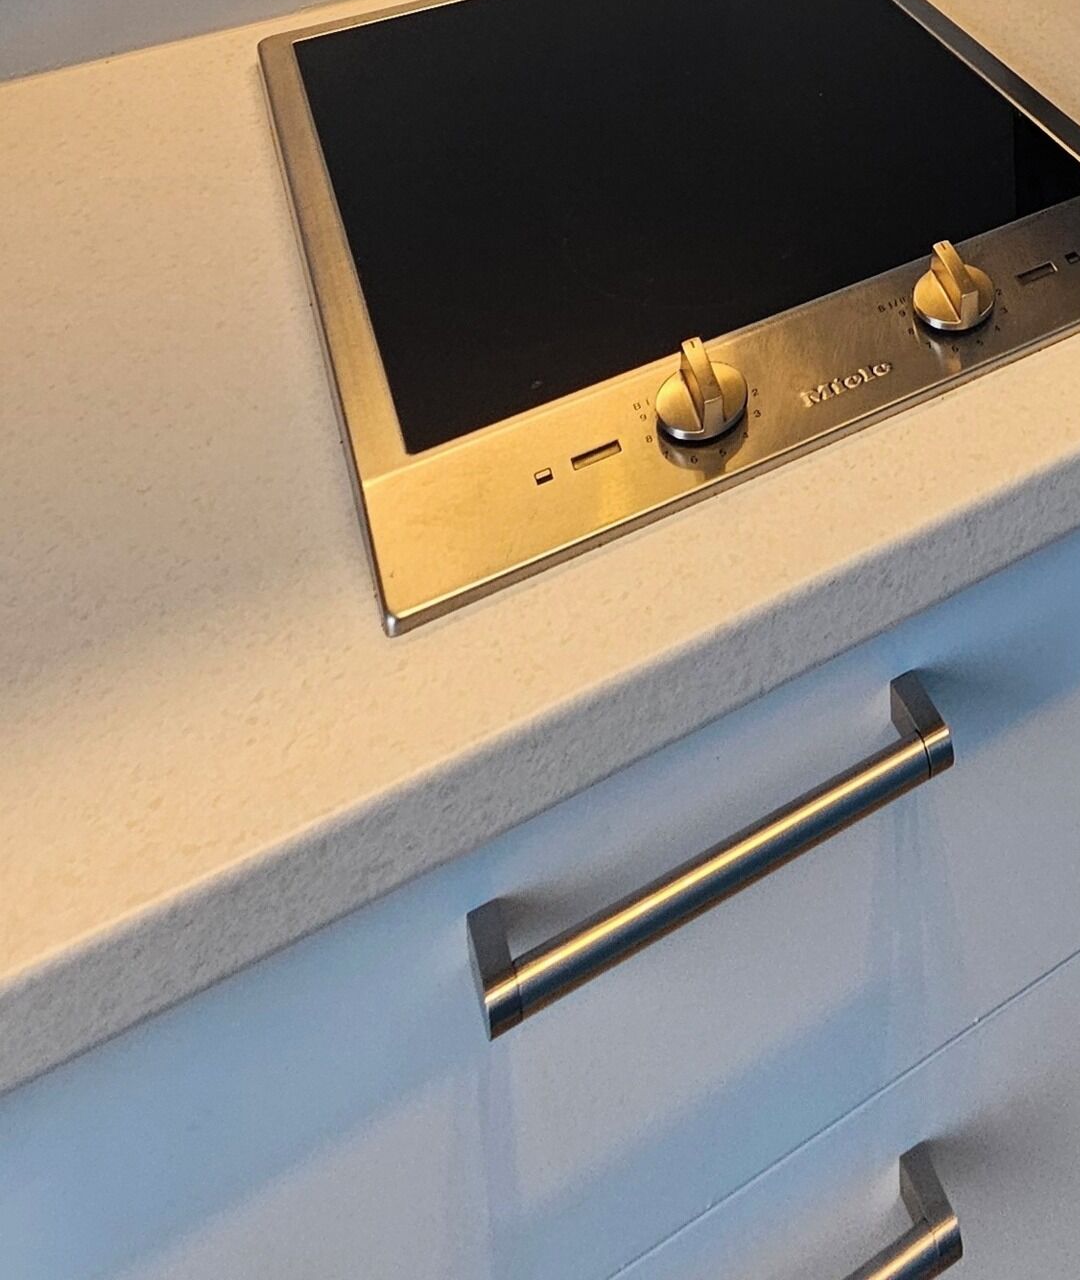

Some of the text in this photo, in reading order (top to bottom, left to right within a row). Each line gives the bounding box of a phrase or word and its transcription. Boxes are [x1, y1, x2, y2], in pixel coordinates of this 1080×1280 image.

[800, 362, 893, 408] Miele
[752, 388, 759, 396] 2
[753, 409, 761, 418] 3
[646, 435, 653, 444] 8
[690, 456, 698, 464] 6
